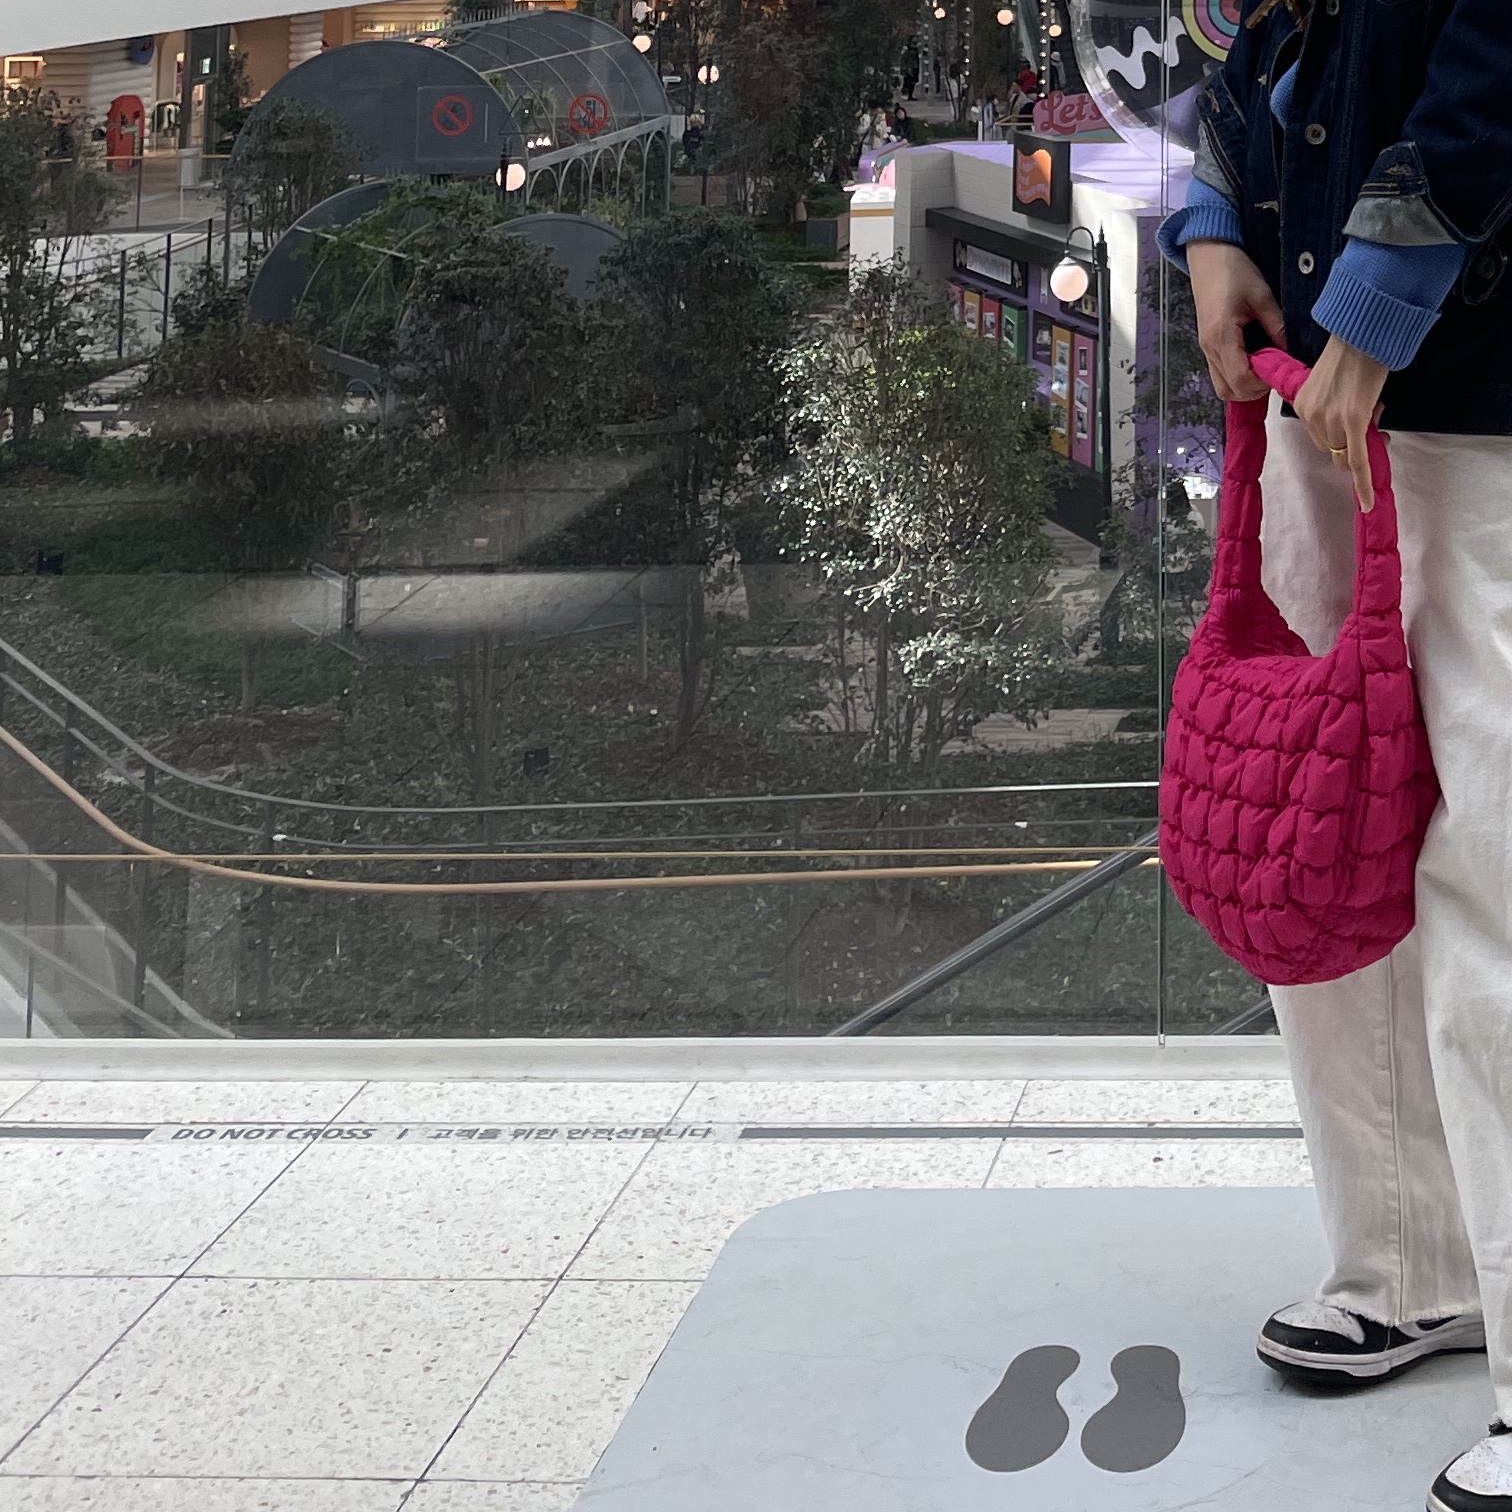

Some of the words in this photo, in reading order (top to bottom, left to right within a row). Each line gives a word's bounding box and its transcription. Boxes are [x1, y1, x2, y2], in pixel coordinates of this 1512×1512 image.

[171, 1128, 217, 1140] DO
[219, 1128, 285, 1140] NOT
[286, 1128, 377, 1140] CROSS
[511, 1128, 559, 1140] 위한
[566, 1126, 713, 1140] 안전선입니다
